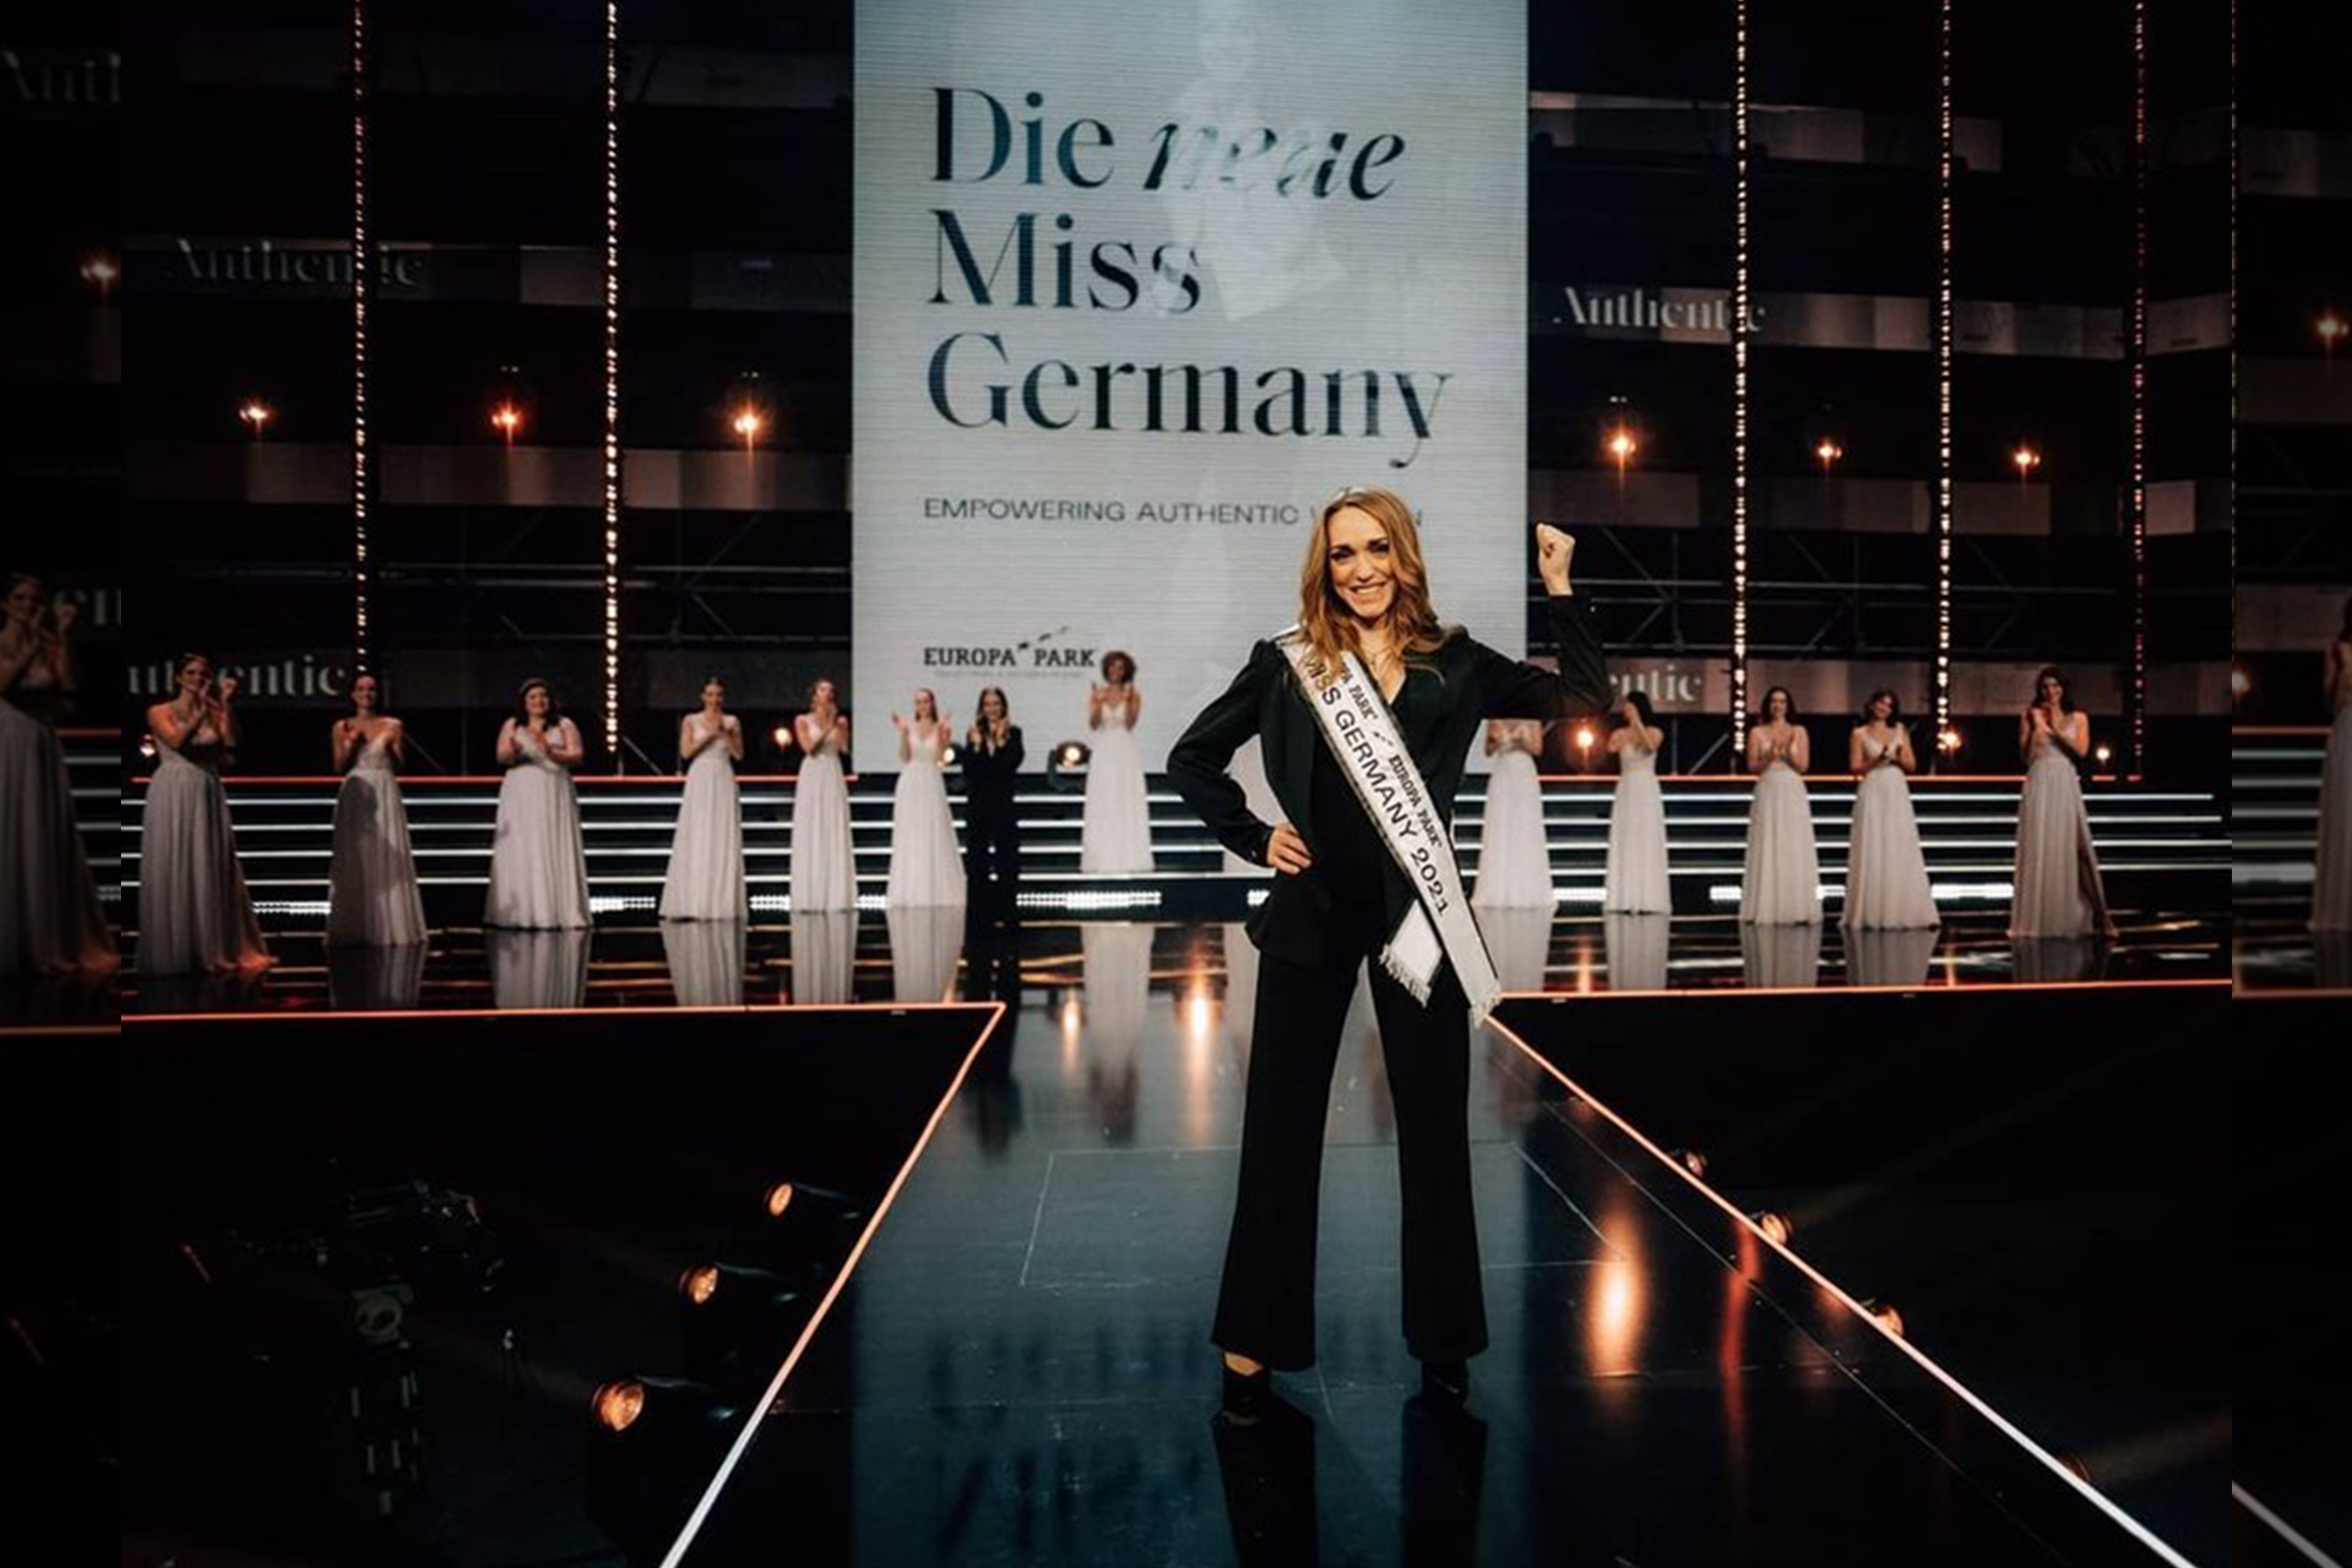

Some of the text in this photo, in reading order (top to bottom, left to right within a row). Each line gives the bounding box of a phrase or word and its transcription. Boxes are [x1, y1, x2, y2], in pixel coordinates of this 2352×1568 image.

[930, 86, 1115, 189] Die
[926, 209, 1201, 312] Miss
[927, 331, 1454, 468] Germany
[924, 498, 1125, 523] EMPOWERING
[1136, 501, 1299, 525] AUTHENTIC
[924, 647, 1095, 667] EUROPA PARK
[1335, 710, 1418, 837] GERMANY
[1411, 848, 1448, 916] 2021
[1388, 754, 1422, 807] EUROPA
